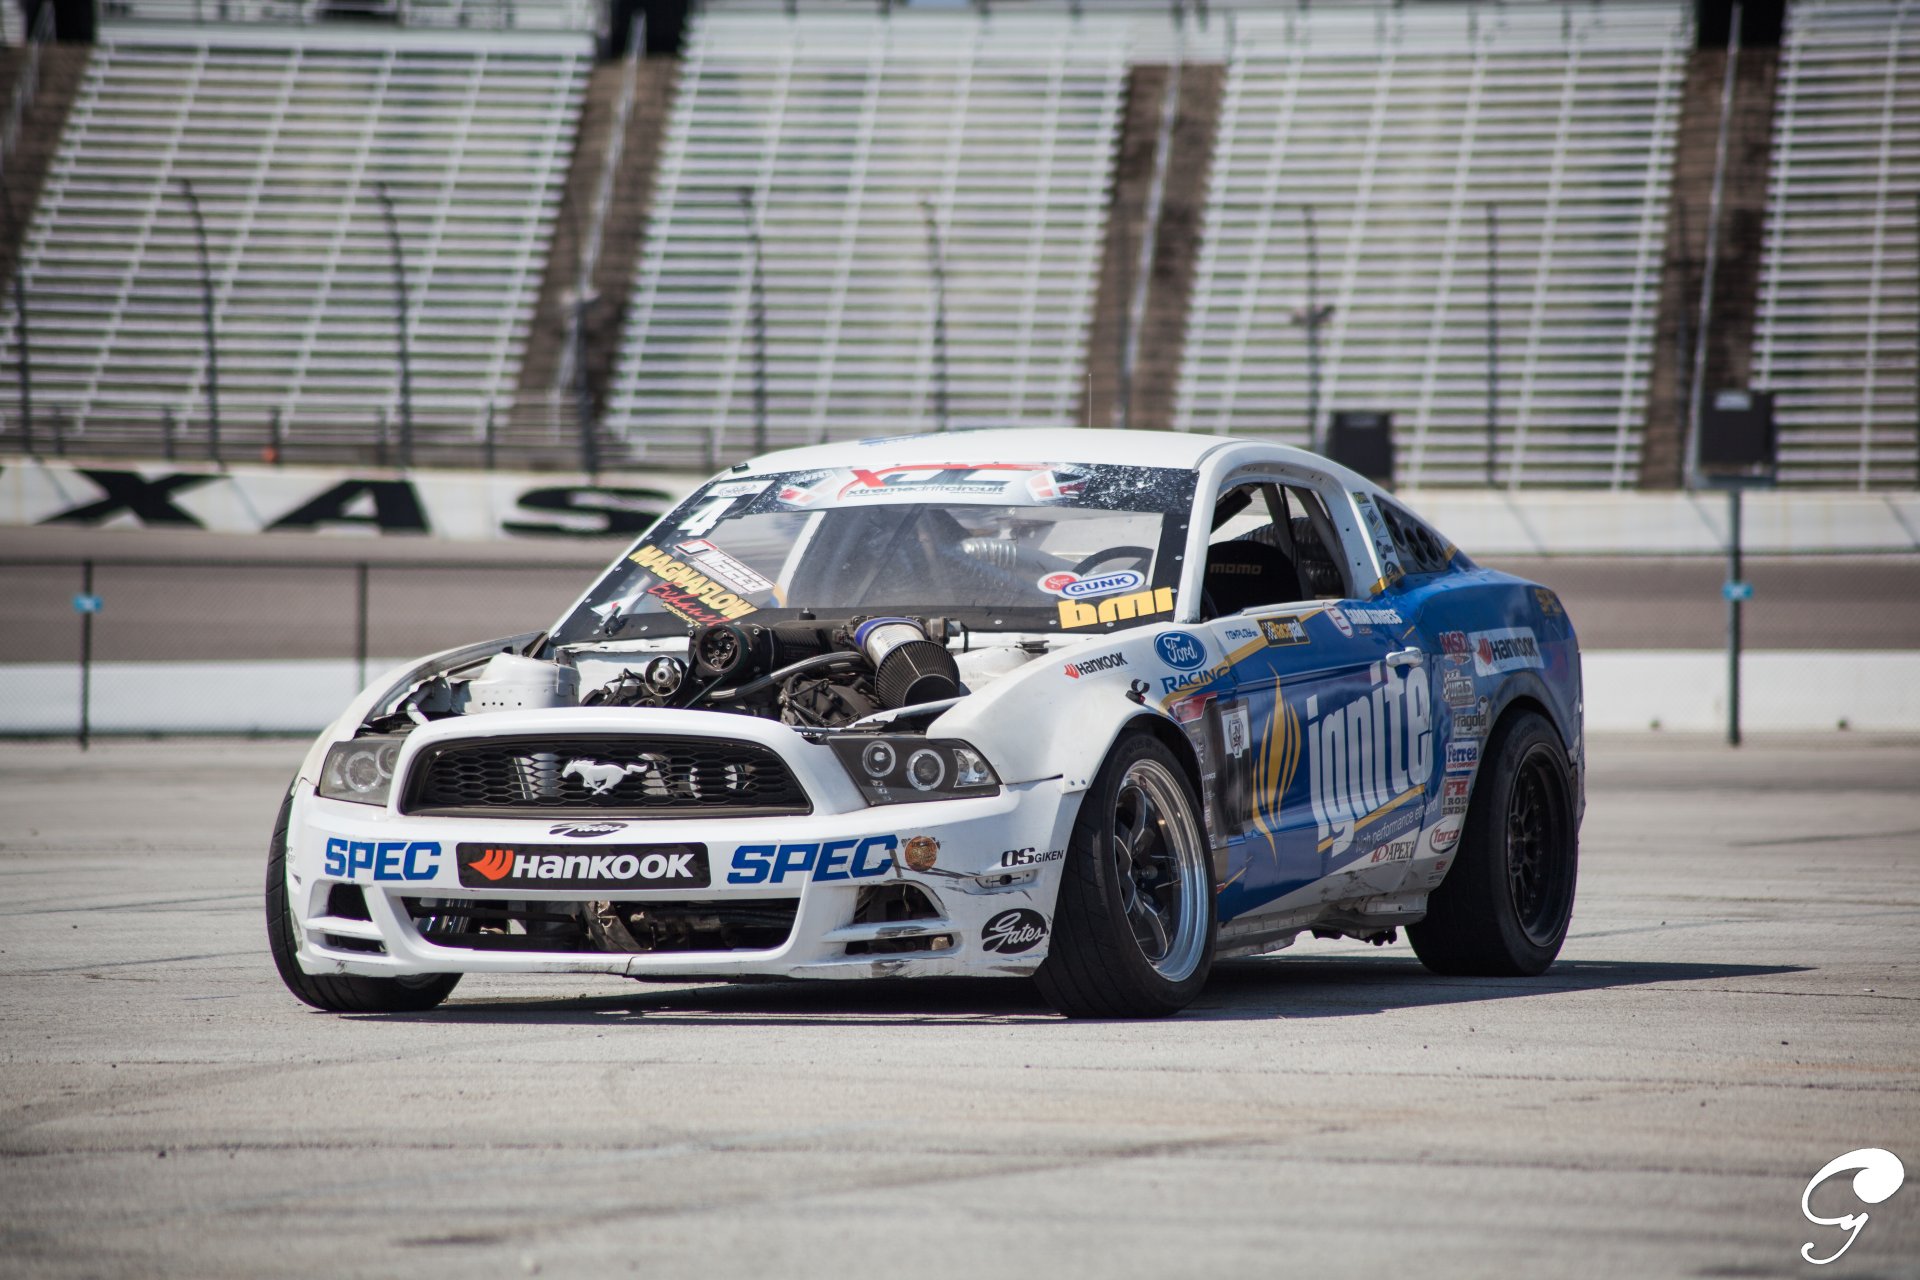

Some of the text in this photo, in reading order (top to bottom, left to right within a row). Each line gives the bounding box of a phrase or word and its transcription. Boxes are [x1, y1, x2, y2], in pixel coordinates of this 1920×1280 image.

[0, 466, 675, 537] XAS
[678, 497, 738, 537] 4
[628, 545, 759, 619] MAGNAFLOW
[1071, 576, 1128, 592] GUNK
[1058, 587, 1174, 629] bmi
[1164, 636, 1198, 663] Ford
[1439, 631, 1469, 655] MSD
[1160, 665, 1231, 694] RACING
[1453, 711, 1487, 731] Fragola
[1307, 660, 1433, 857] ignite
[1447, 743, 1478, 762] Ferrea
[1442, 806, 1466, 816] ENDS
[1448, 796, 1467, 806] ROD
[1372, 811, 1414, 844] performance
[1433, 828, 1460, 844] Torco
[324, 838, 442, 881] SPEC
[727, 834, 899, 884] SPEC
[1001, 847, 1064, 867] OS GIKEN
[983, 911, 1049, 953] Gates
